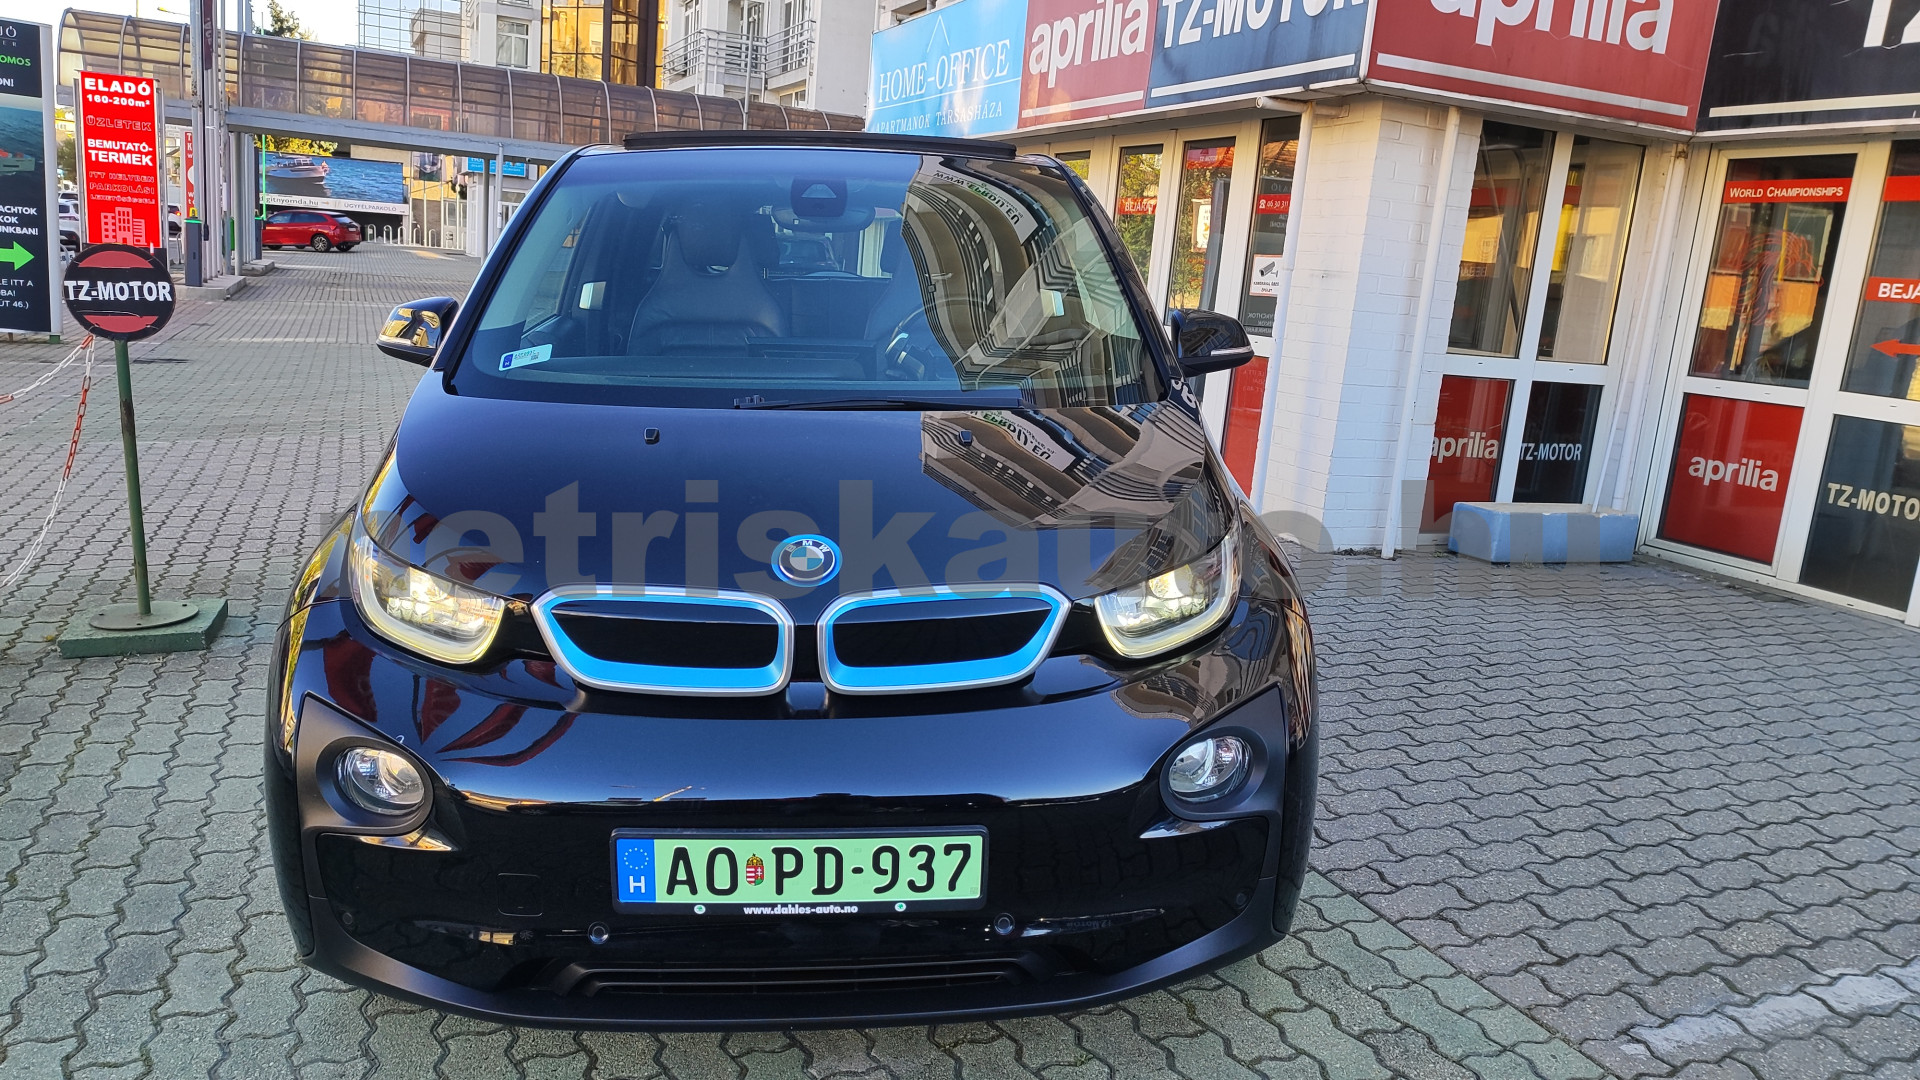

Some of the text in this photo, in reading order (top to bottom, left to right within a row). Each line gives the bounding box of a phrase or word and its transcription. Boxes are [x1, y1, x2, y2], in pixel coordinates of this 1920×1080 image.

[1163, 0, 1367, 48] TZ-MO
[1028, 0, 1147, 88] aprilia
[878, 40, 1010, 103] HOME-OFFICE
[84, 77, 151, 96] ELADÓ
[875, 100, 1002, 133] APARTMANOK TÁRSASHÁZA
[87, 138, 153, 152] BEMUTATÓ-
[88, 149, 153, 166] TERMEK
[0, 226, 38, 235] NKBAN!
[64, 280, 172, 302] TZ-MOTOR
[1520, 443, 1582, 461] TZ-MOTOR
[1688, 456, 1779, 492] aprilia
[1827, 483, 1920, 522] TZ-MOTO
[785, 540, 830, 553] BMW
[666, 842, 972, 896] AO PD-937
[629, 875, 646, 894] H
[743, 903, 859, 916] www.dahles-auto.no
